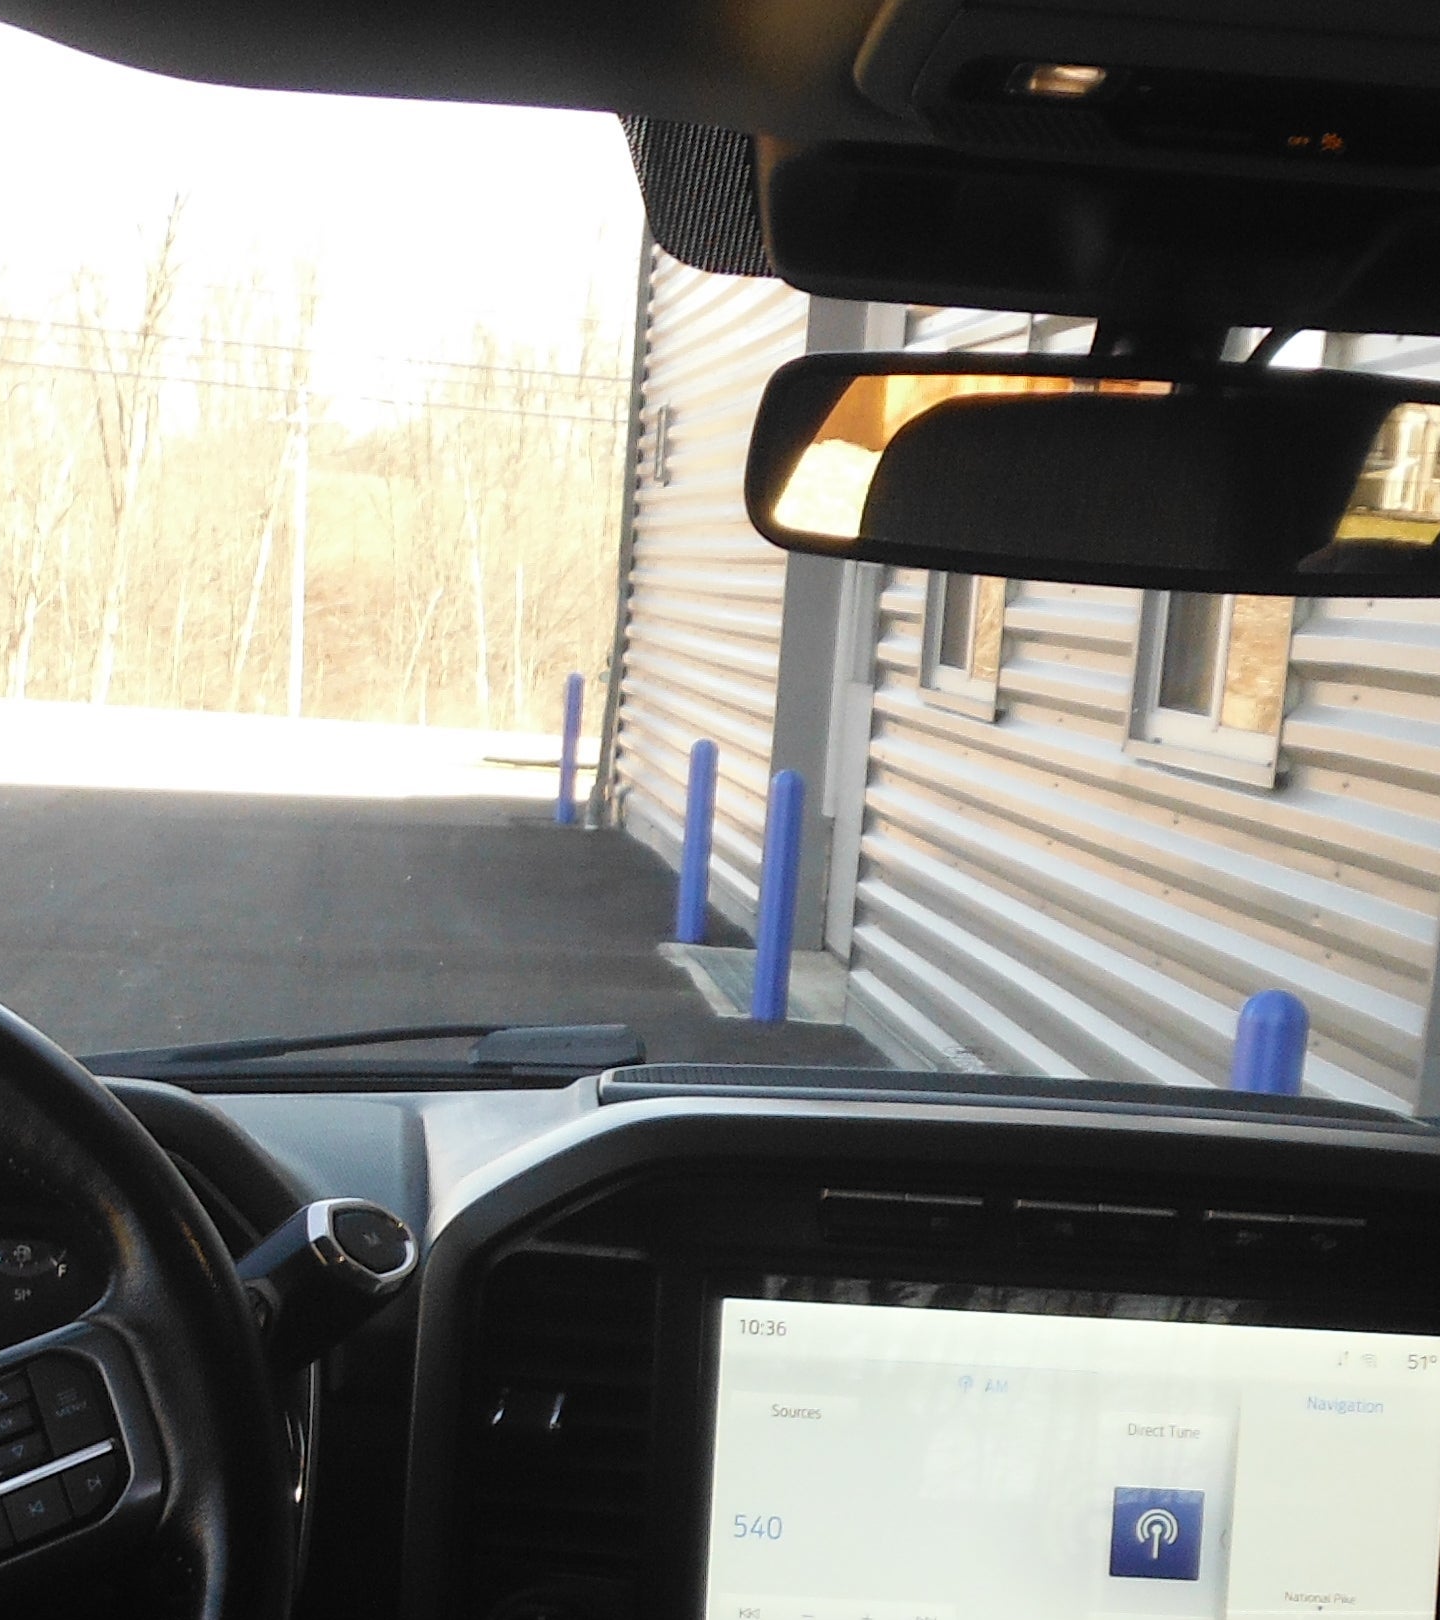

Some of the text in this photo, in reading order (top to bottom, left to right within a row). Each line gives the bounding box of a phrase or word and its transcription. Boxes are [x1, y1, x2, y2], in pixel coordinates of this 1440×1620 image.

[57, 1263, 67, 1278] F
[737, 1317, 788, 1338] 10:36
[984, 1378, 1009, 1394] AM
[770, 1402, 823, 1421] Sources
[1307, 1395, 1385, 1416] Navigation
[1127, 1422, 1201, 1439] Direct Tune
[732, 1513, 784, 1541] 540
